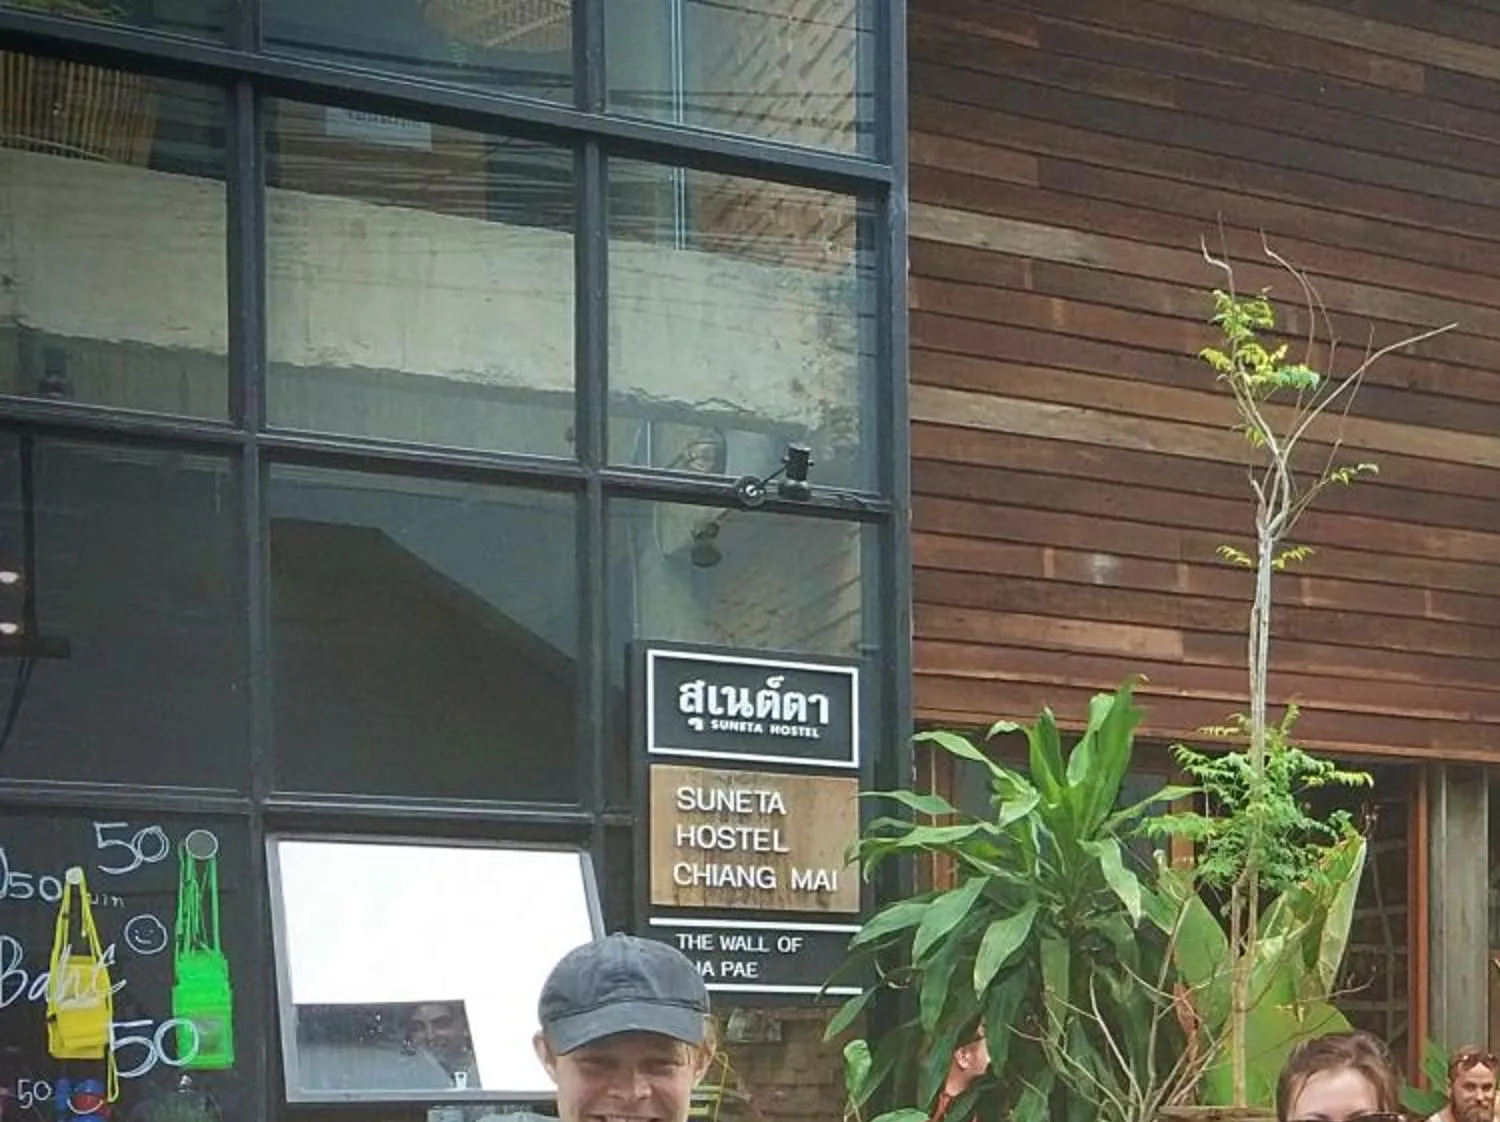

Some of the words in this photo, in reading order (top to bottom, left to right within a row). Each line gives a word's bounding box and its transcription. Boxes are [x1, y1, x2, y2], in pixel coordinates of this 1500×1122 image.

[710, 718, 764, 734] SUNETA
[769, 724, 821, 739] HOSTEL
[676, 786, 787, 815] SUNETA
[94, 822, 169, 874] 50
[676, 823, 790, 852] HOSTEL
[672, 862, 777, 889] CHIANG
[791, 867, 838, 891] MAI
[676, 933, 714, 950] THE
[719, 934, 770, 952] WALL
[777, 935, 804, 953] OF
[721, 961, 759, 978] PAE
[112, 1019, 198, 1078] 50
[17, 1079, 52, 1109] 50
